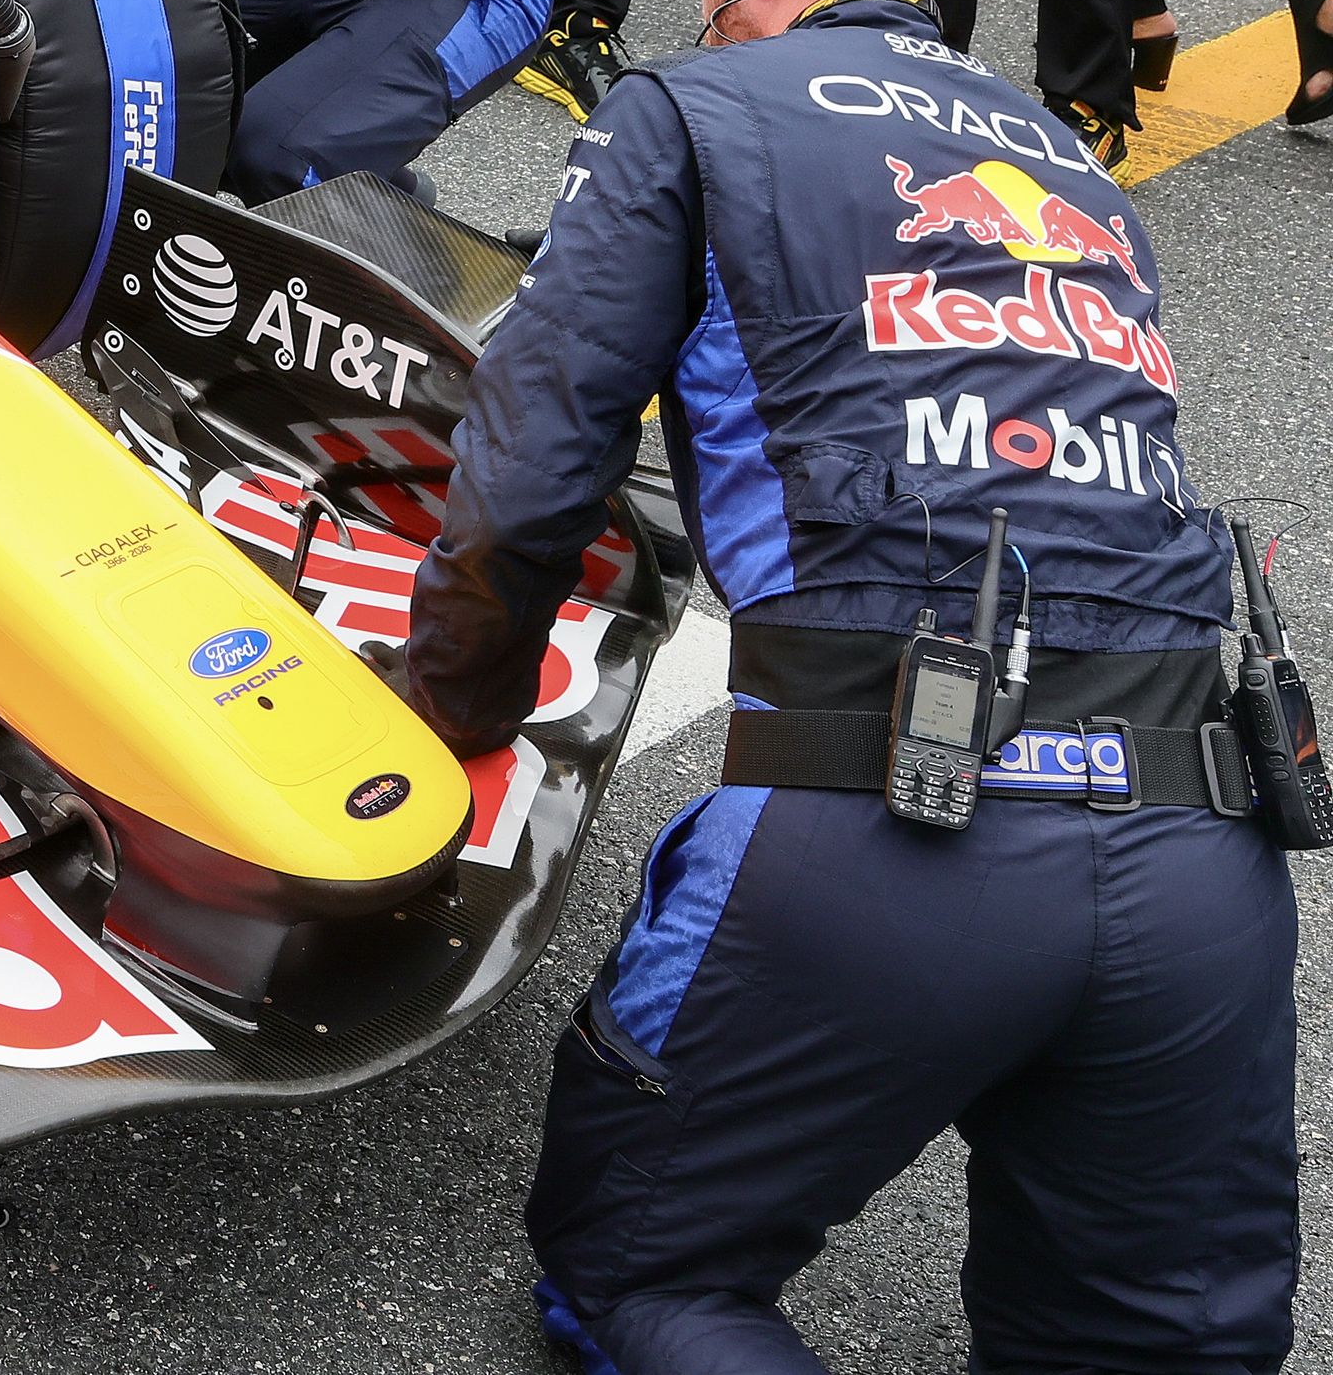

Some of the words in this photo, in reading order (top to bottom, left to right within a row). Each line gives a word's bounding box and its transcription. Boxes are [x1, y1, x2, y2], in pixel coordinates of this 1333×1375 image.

[123, 78, 145, 167] Left
[140, 81, 164, 172] Fron
[808, 75, 1118, 183] ORACLE
[246, 288, 433, 410] AT&T
[863, 263, 1078, 356] Red
[905, 393, 1148, 497] Mobil
[75, 542, 115, 568] CIAO
[115, 523, 158, 551] ALEX
[207, 632, 260, 673] Ford
[213, 655, 304, 707] RACING
[995, 729, 1126, 779] arco
[363, 787, 404, 817] RACING
